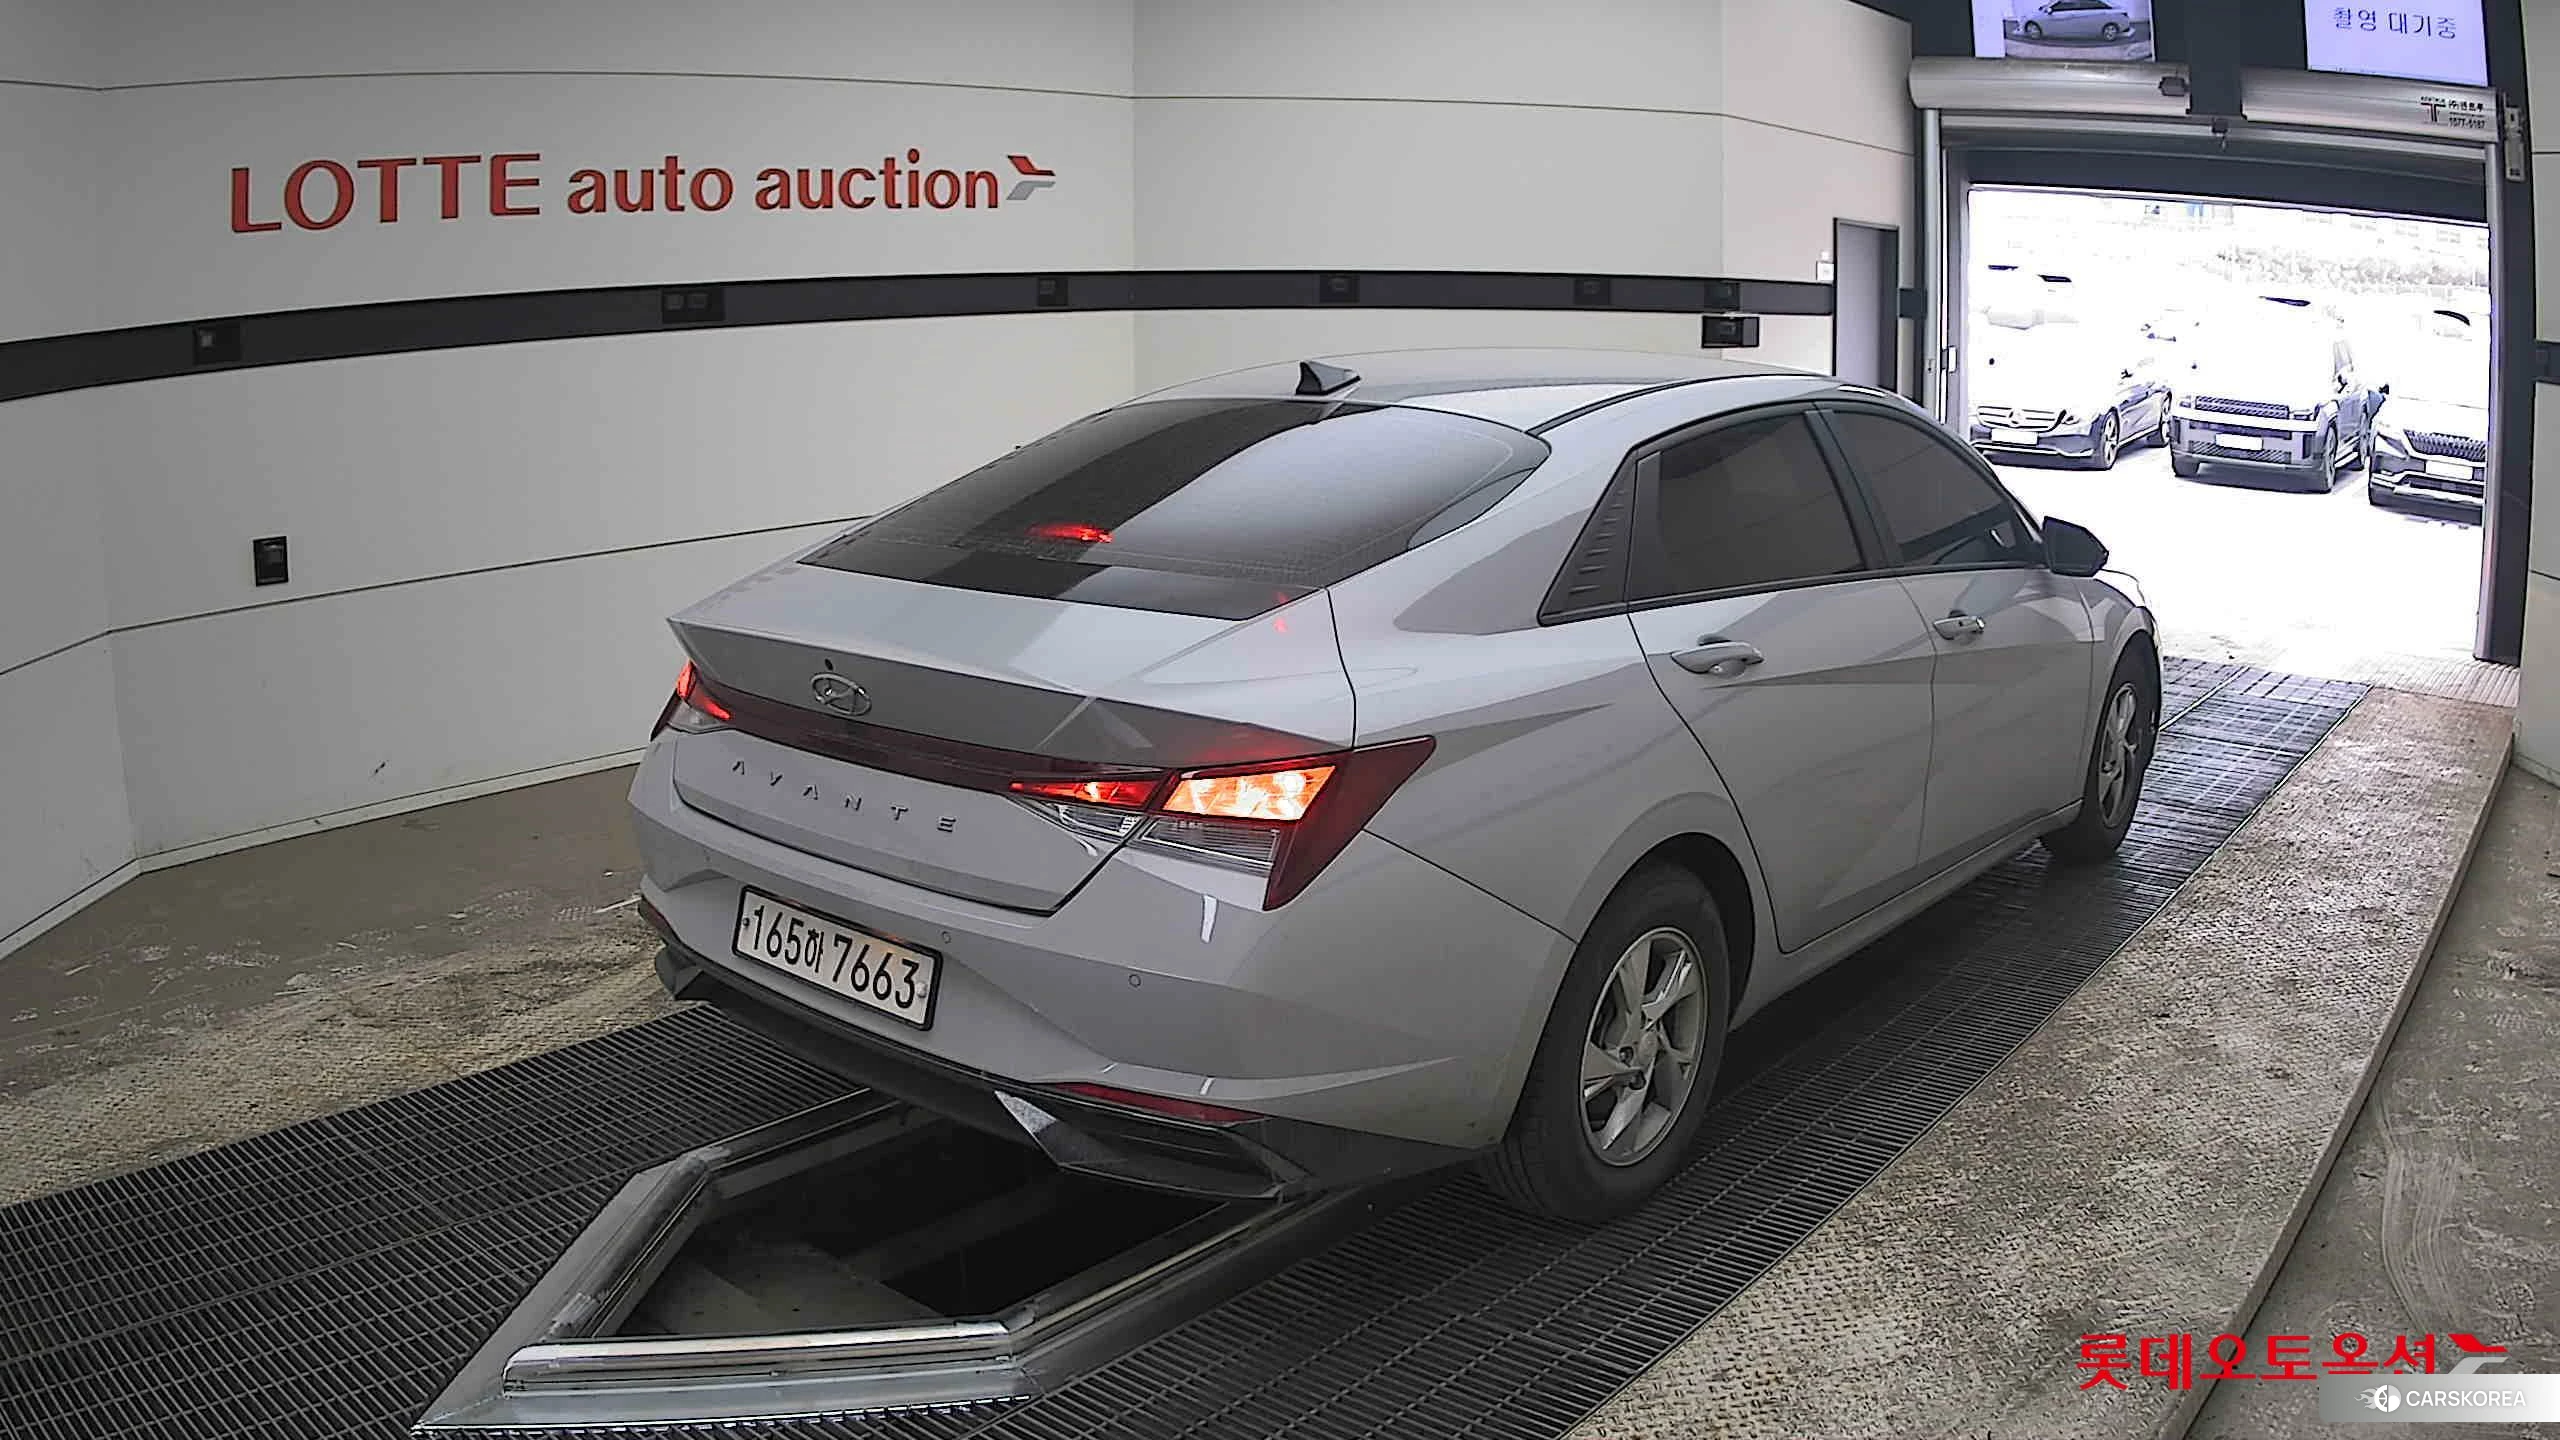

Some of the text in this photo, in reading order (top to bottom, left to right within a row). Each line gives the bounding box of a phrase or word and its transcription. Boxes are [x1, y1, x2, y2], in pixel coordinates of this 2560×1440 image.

[2334, 7, 2377, 32] 촬영
[231, 148, 999, 233] LOTTE auto auction
[732, 760, 956, 833] AVANTE
[753, 904, 920, 1010] 165하 7663
